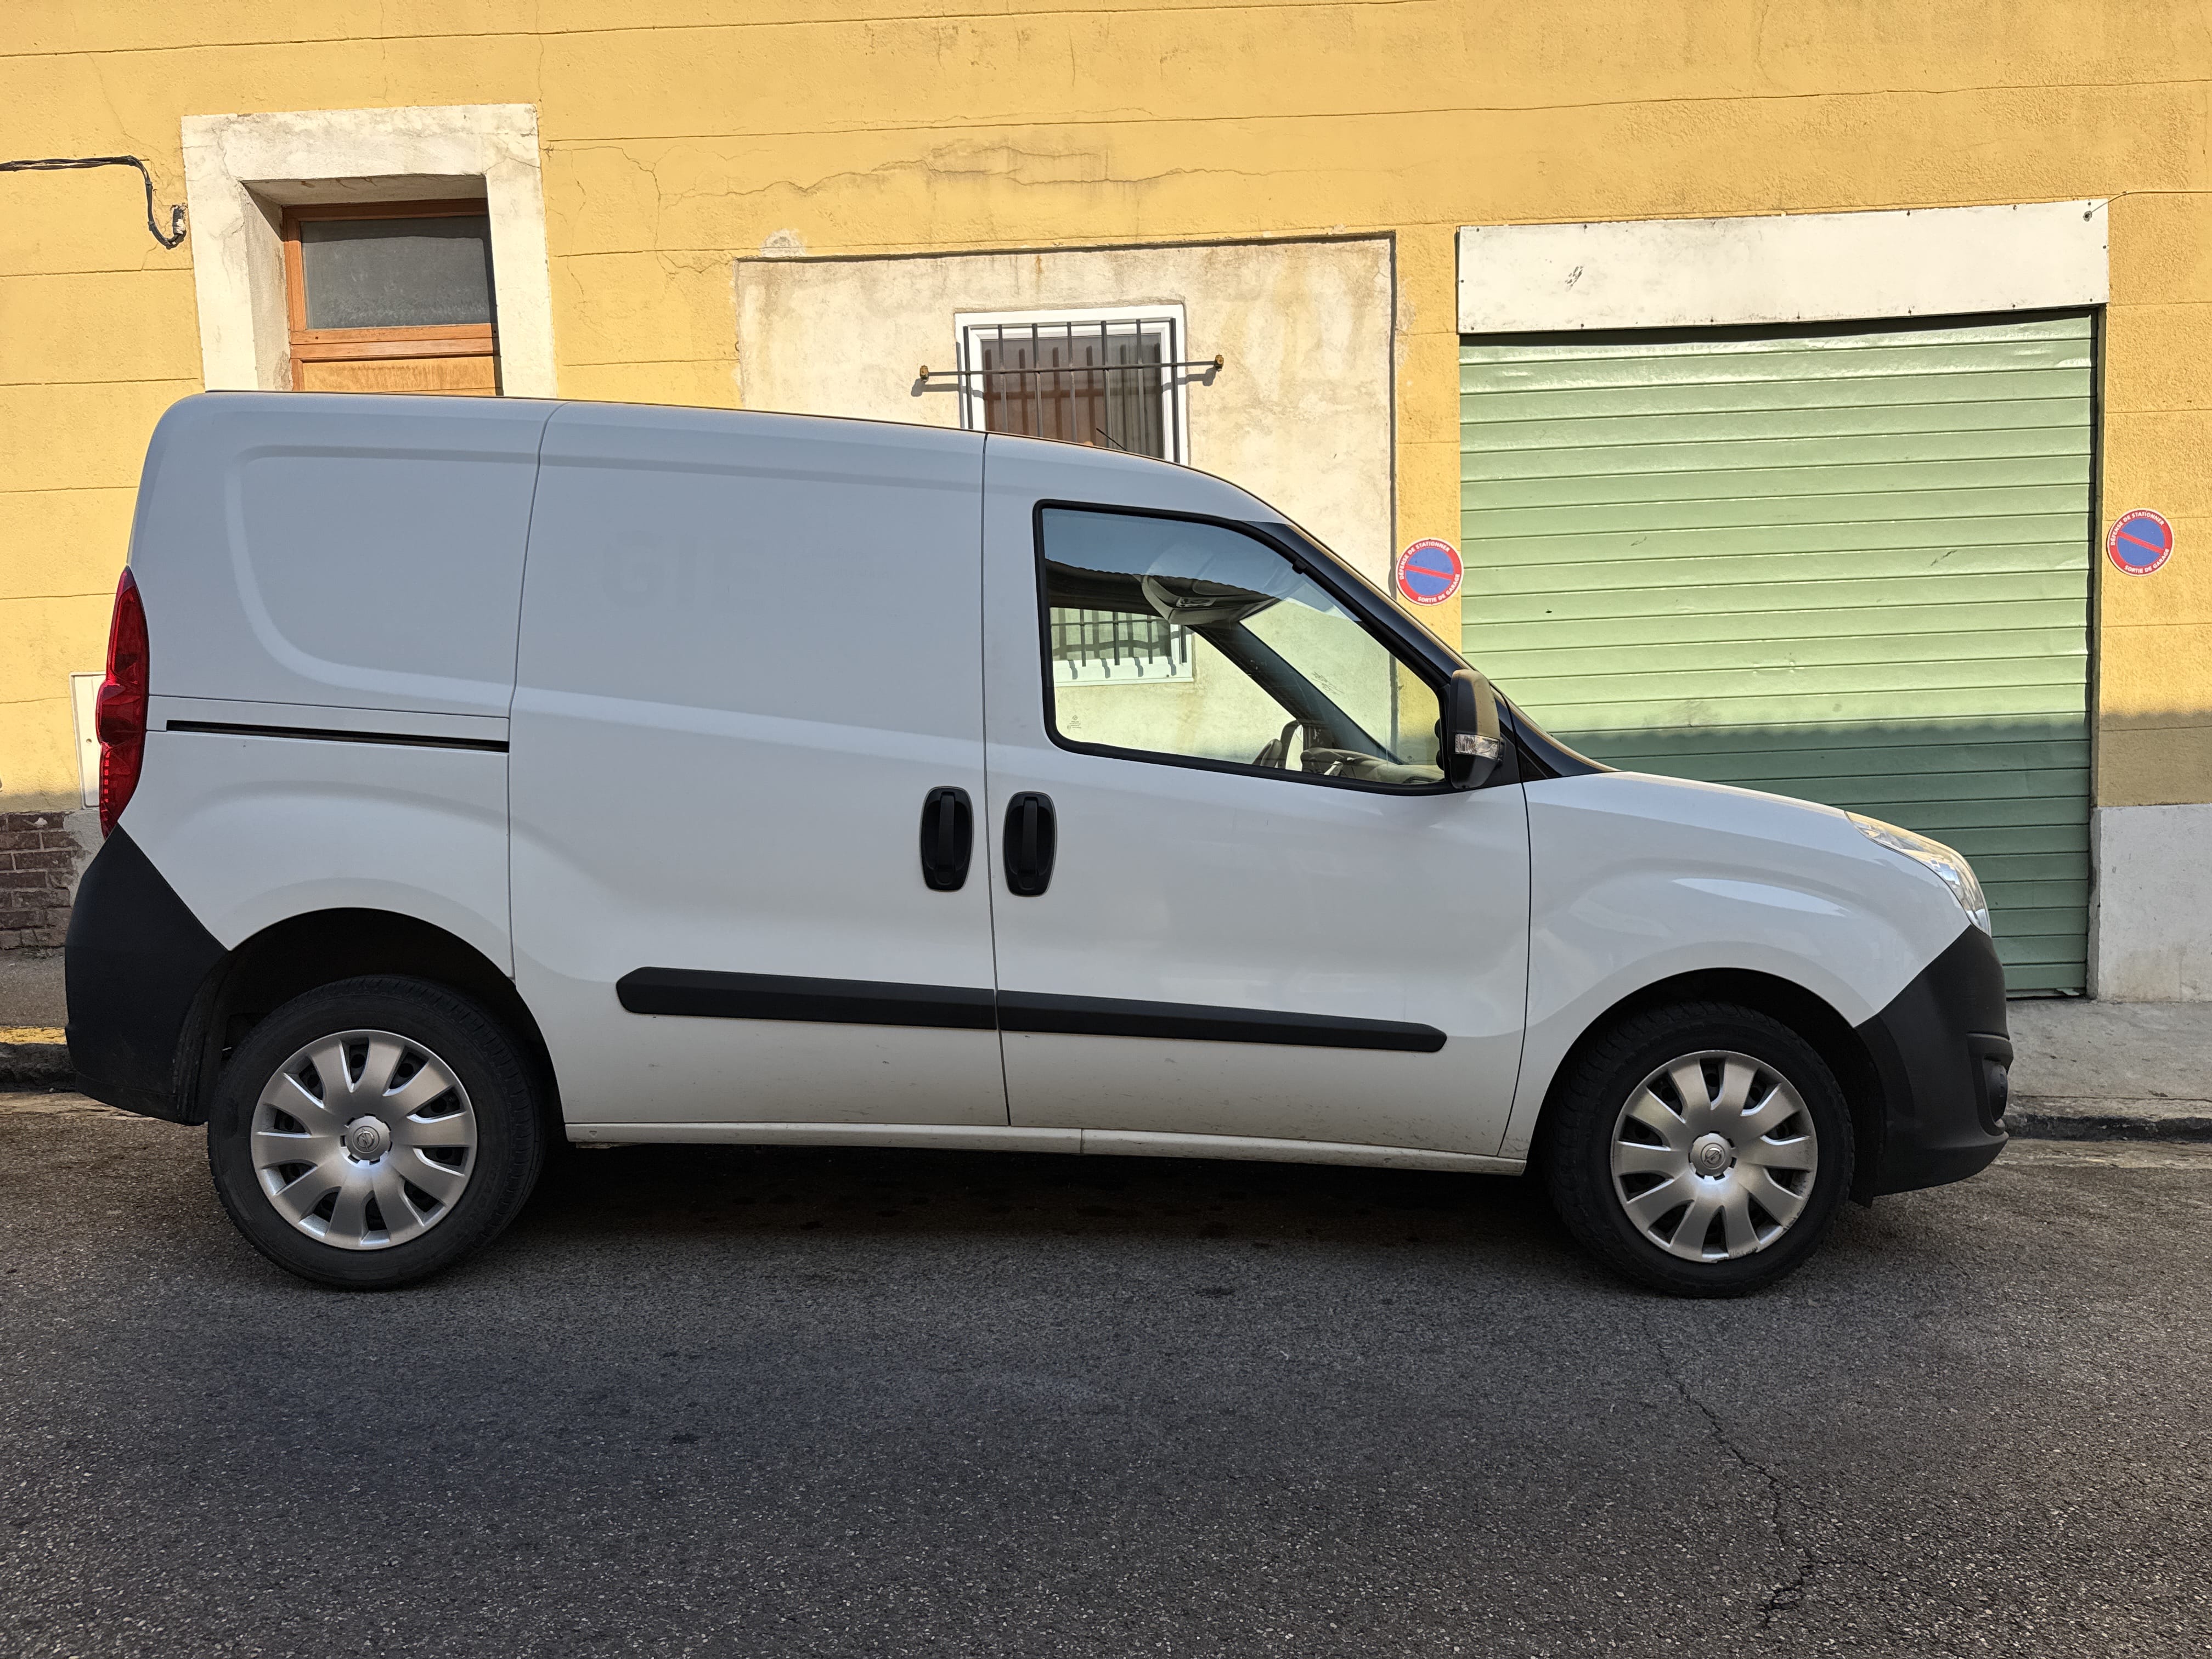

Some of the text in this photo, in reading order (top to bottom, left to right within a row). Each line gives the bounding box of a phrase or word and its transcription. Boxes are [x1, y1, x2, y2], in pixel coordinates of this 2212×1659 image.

[2131, 511, 2164, 526] STATIONNER
[1416, 541, 1451, 552] STATIONNER
[2124, 565, 2143, 573] SORTIE
[2153, 548, 2170, 568] GARAGE
[1446, 573, 1460, 595] GARAGE
